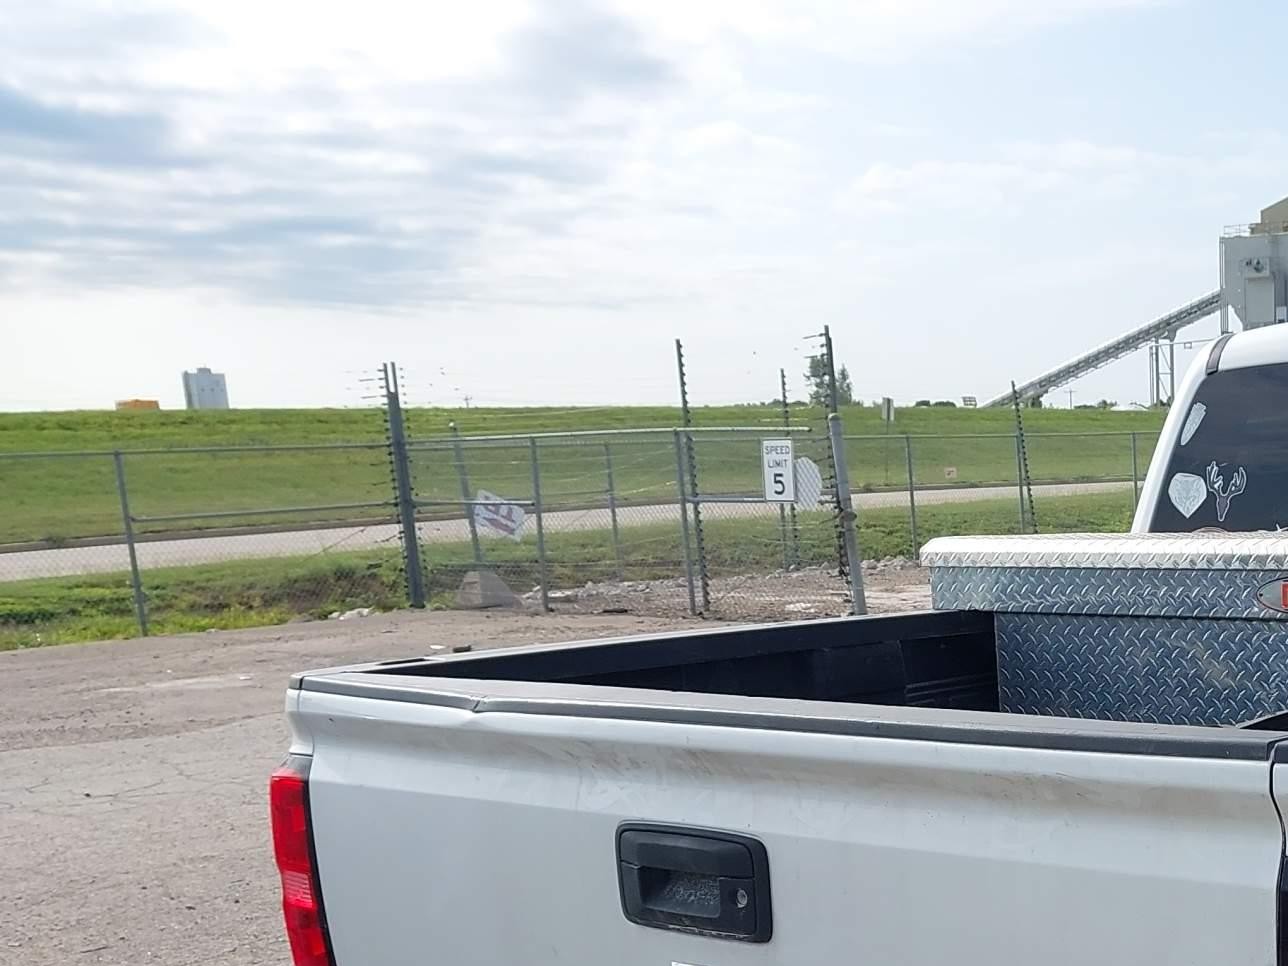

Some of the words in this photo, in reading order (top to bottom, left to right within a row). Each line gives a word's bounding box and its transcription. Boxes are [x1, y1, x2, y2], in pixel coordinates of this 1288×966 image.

[765, 445, 790, 455] SPEED
[768, 459, 789, 469] LIMIT
[773, 473, 785, 495] 5
